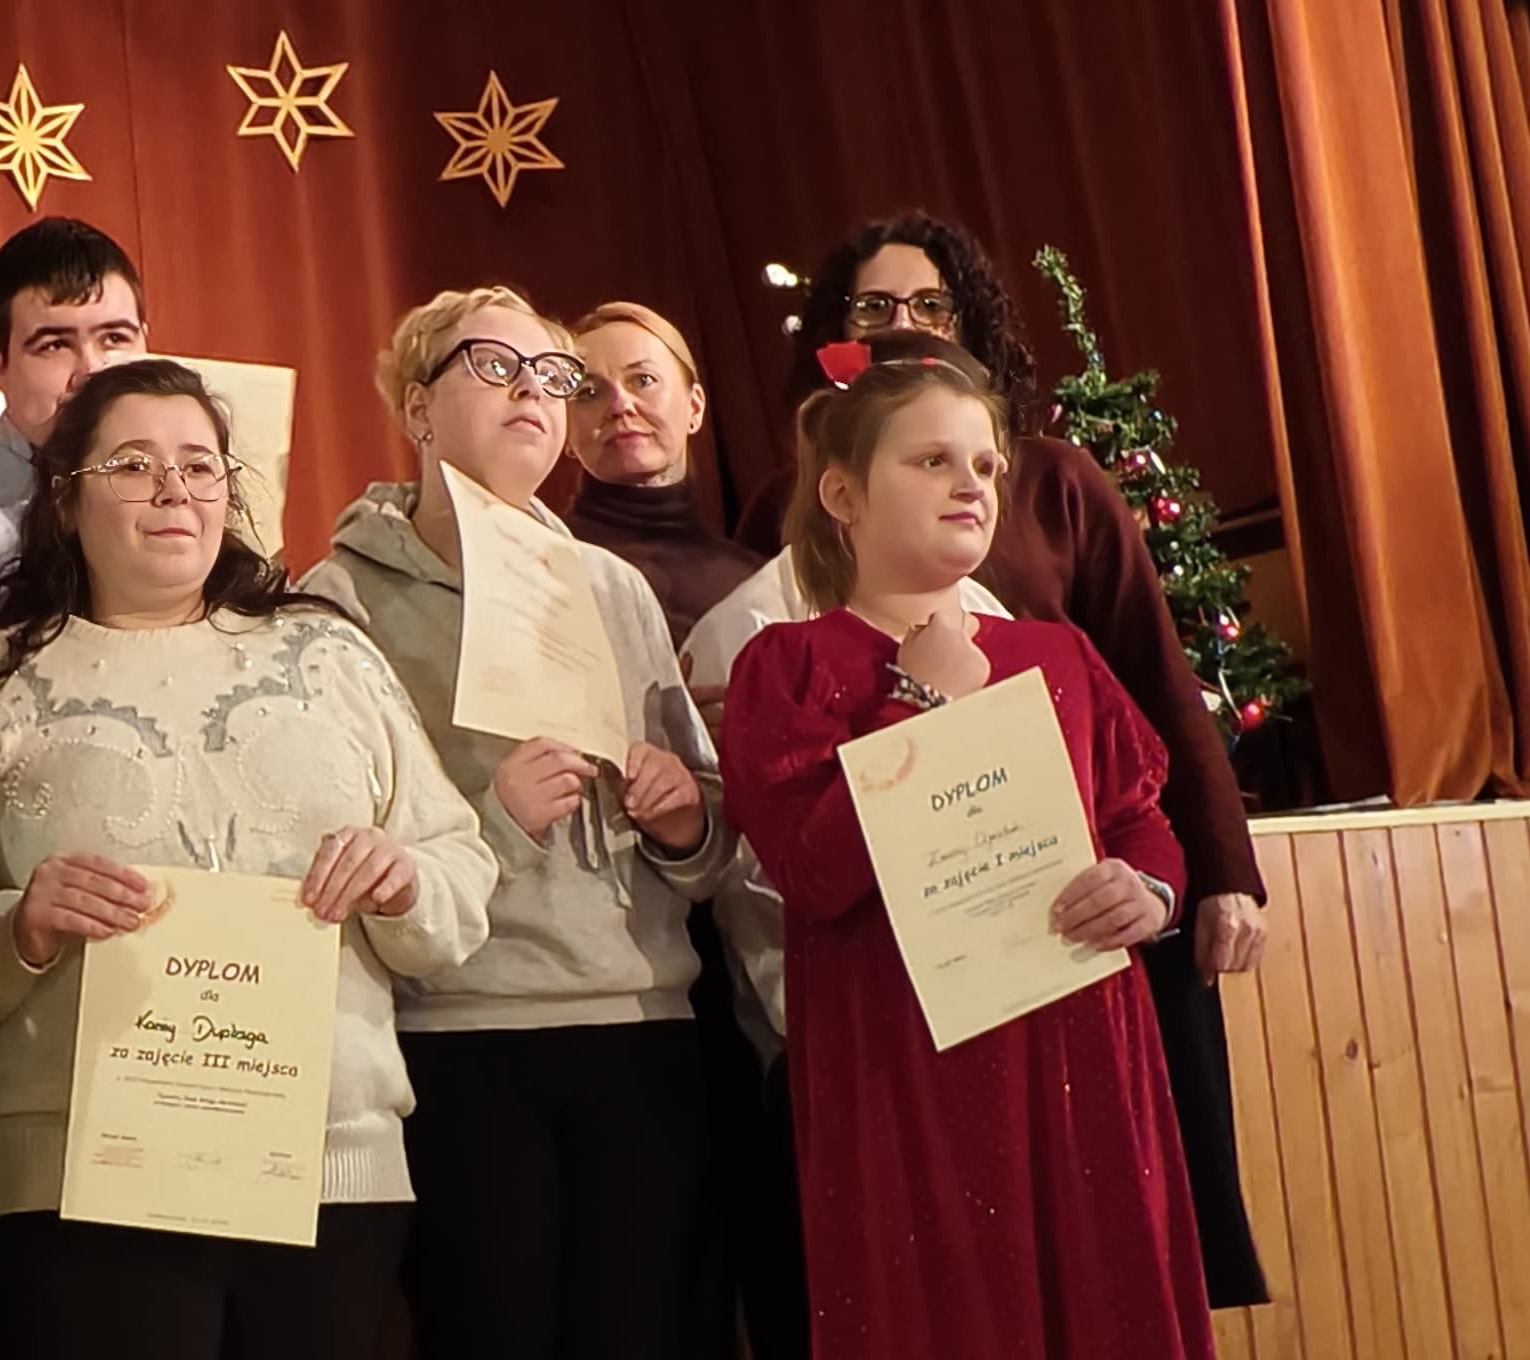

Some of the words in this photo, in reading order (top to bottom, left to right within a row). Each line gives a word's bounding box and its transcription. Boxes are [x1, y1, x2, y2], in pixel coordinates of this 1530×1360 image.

[931, 767, 1008, 811] DYPLOM
[165, 956, 261, 984] DYPLOM
[110, 1046, 129, 1059] za
[136, 1046, 194, 1067] zajęcie
[201, 1052, 231, 1069] III
[236, 1058, 299, 1078] miejsca
